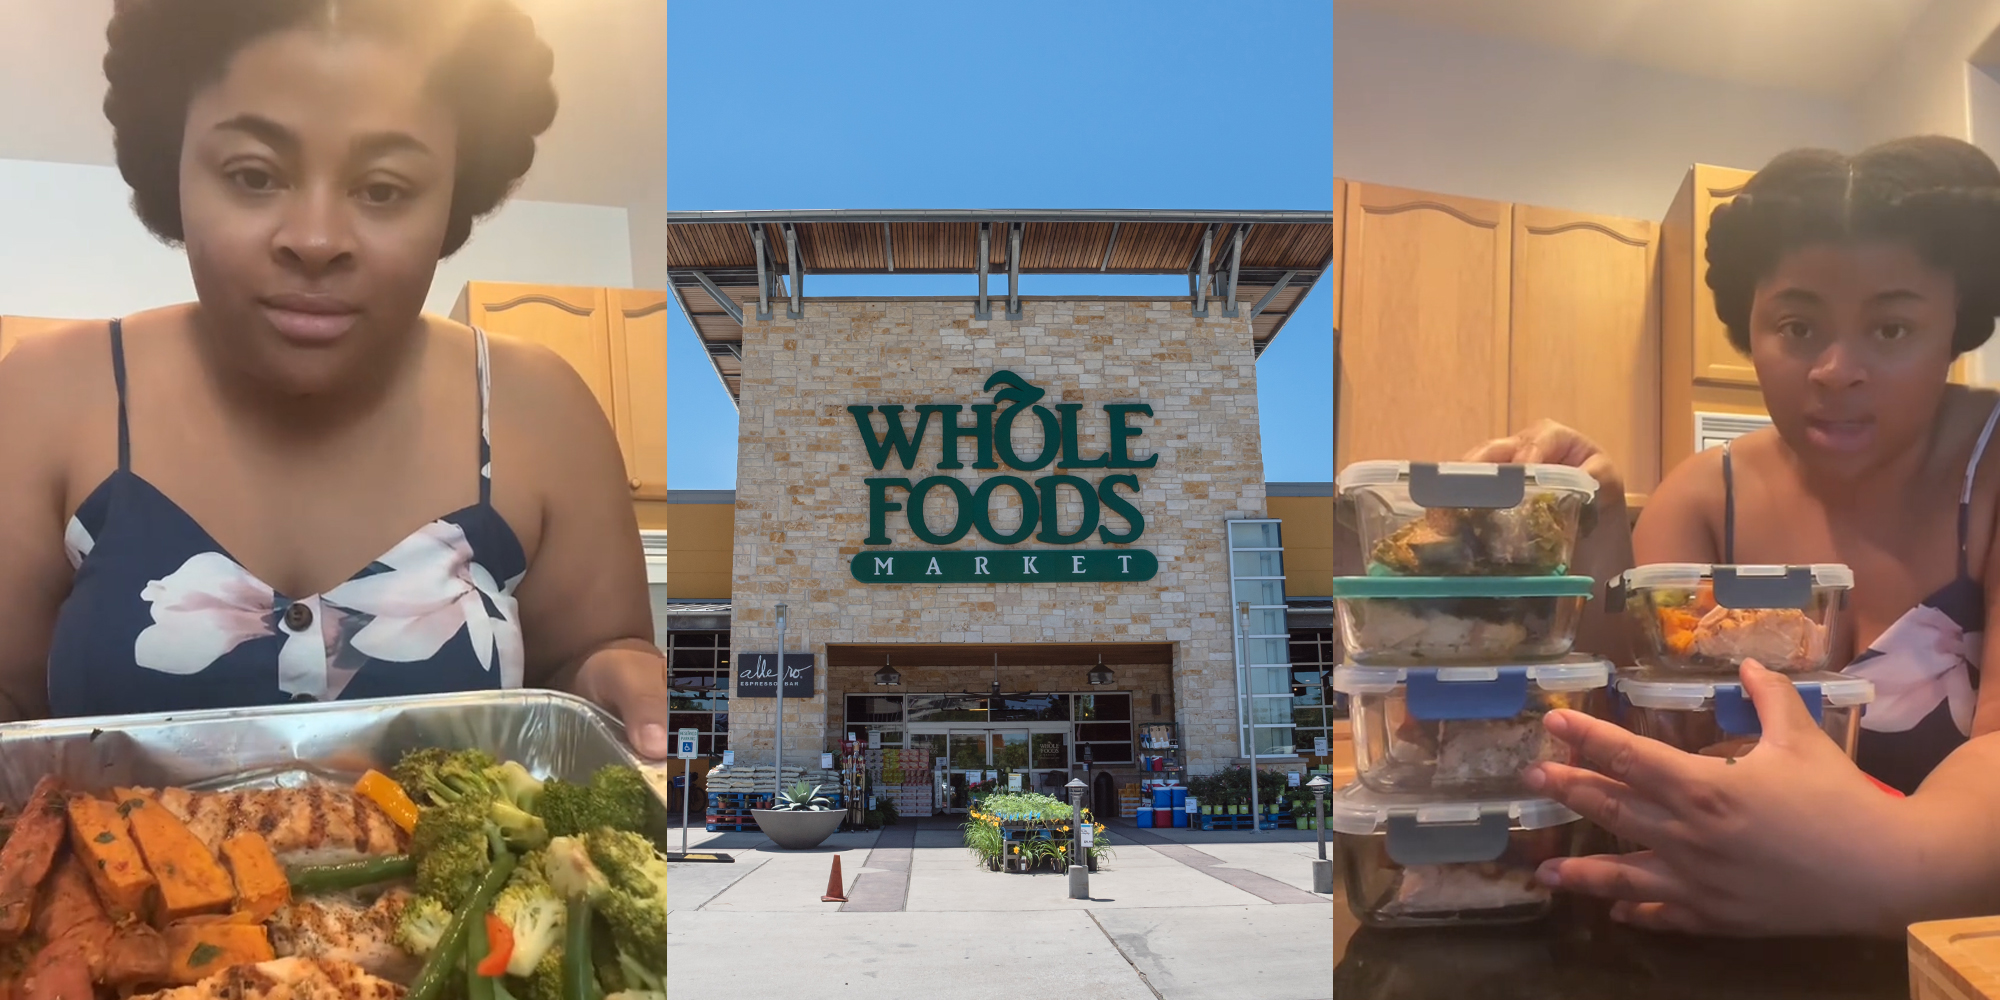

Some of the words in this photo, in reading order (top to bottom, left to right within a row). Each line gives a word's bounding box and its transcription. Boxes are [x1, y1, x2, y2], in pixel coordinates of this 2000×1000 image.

[847, 385, 1159, 471] WHOLE
[864, 474, 1145, 545] FOODS
[873, 555, 1133, 576] MARKET
